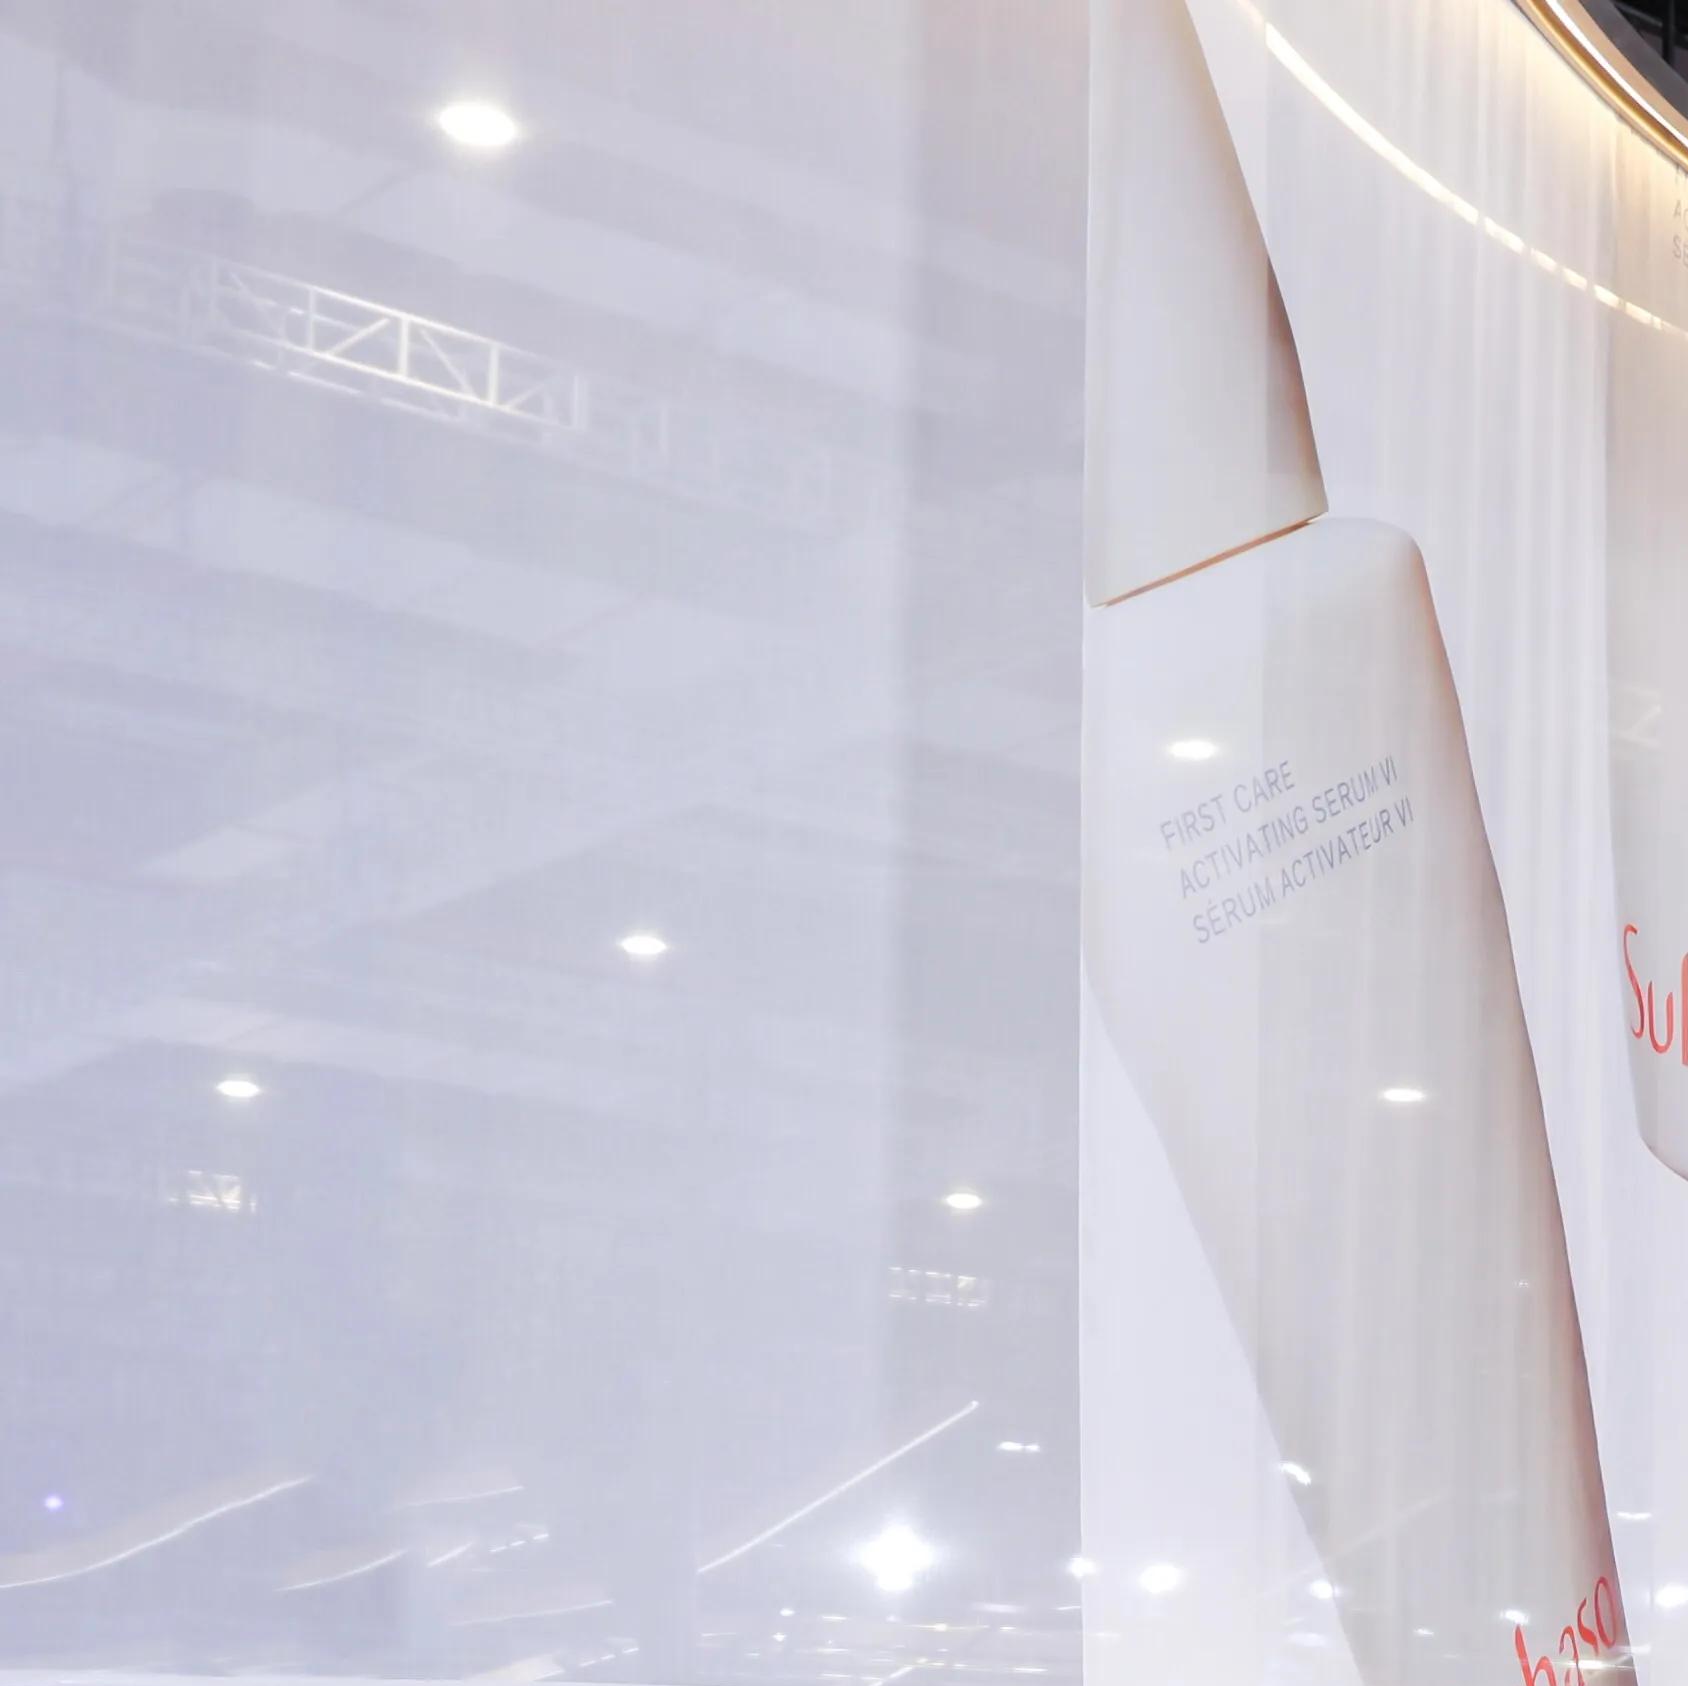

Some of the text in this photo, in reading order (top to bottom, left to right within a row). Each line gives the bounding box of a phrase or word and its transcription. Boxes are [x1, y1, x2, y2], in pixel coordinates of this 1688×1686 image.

[1160, 760, 1295, 851] FIRST CARE
[1180, 755, 1398, 899] ACTIVATING SERUM VI
[1281, 808, 1394, 899] ACTIVATEUR
[1394, 796, 1415, 827] VI
